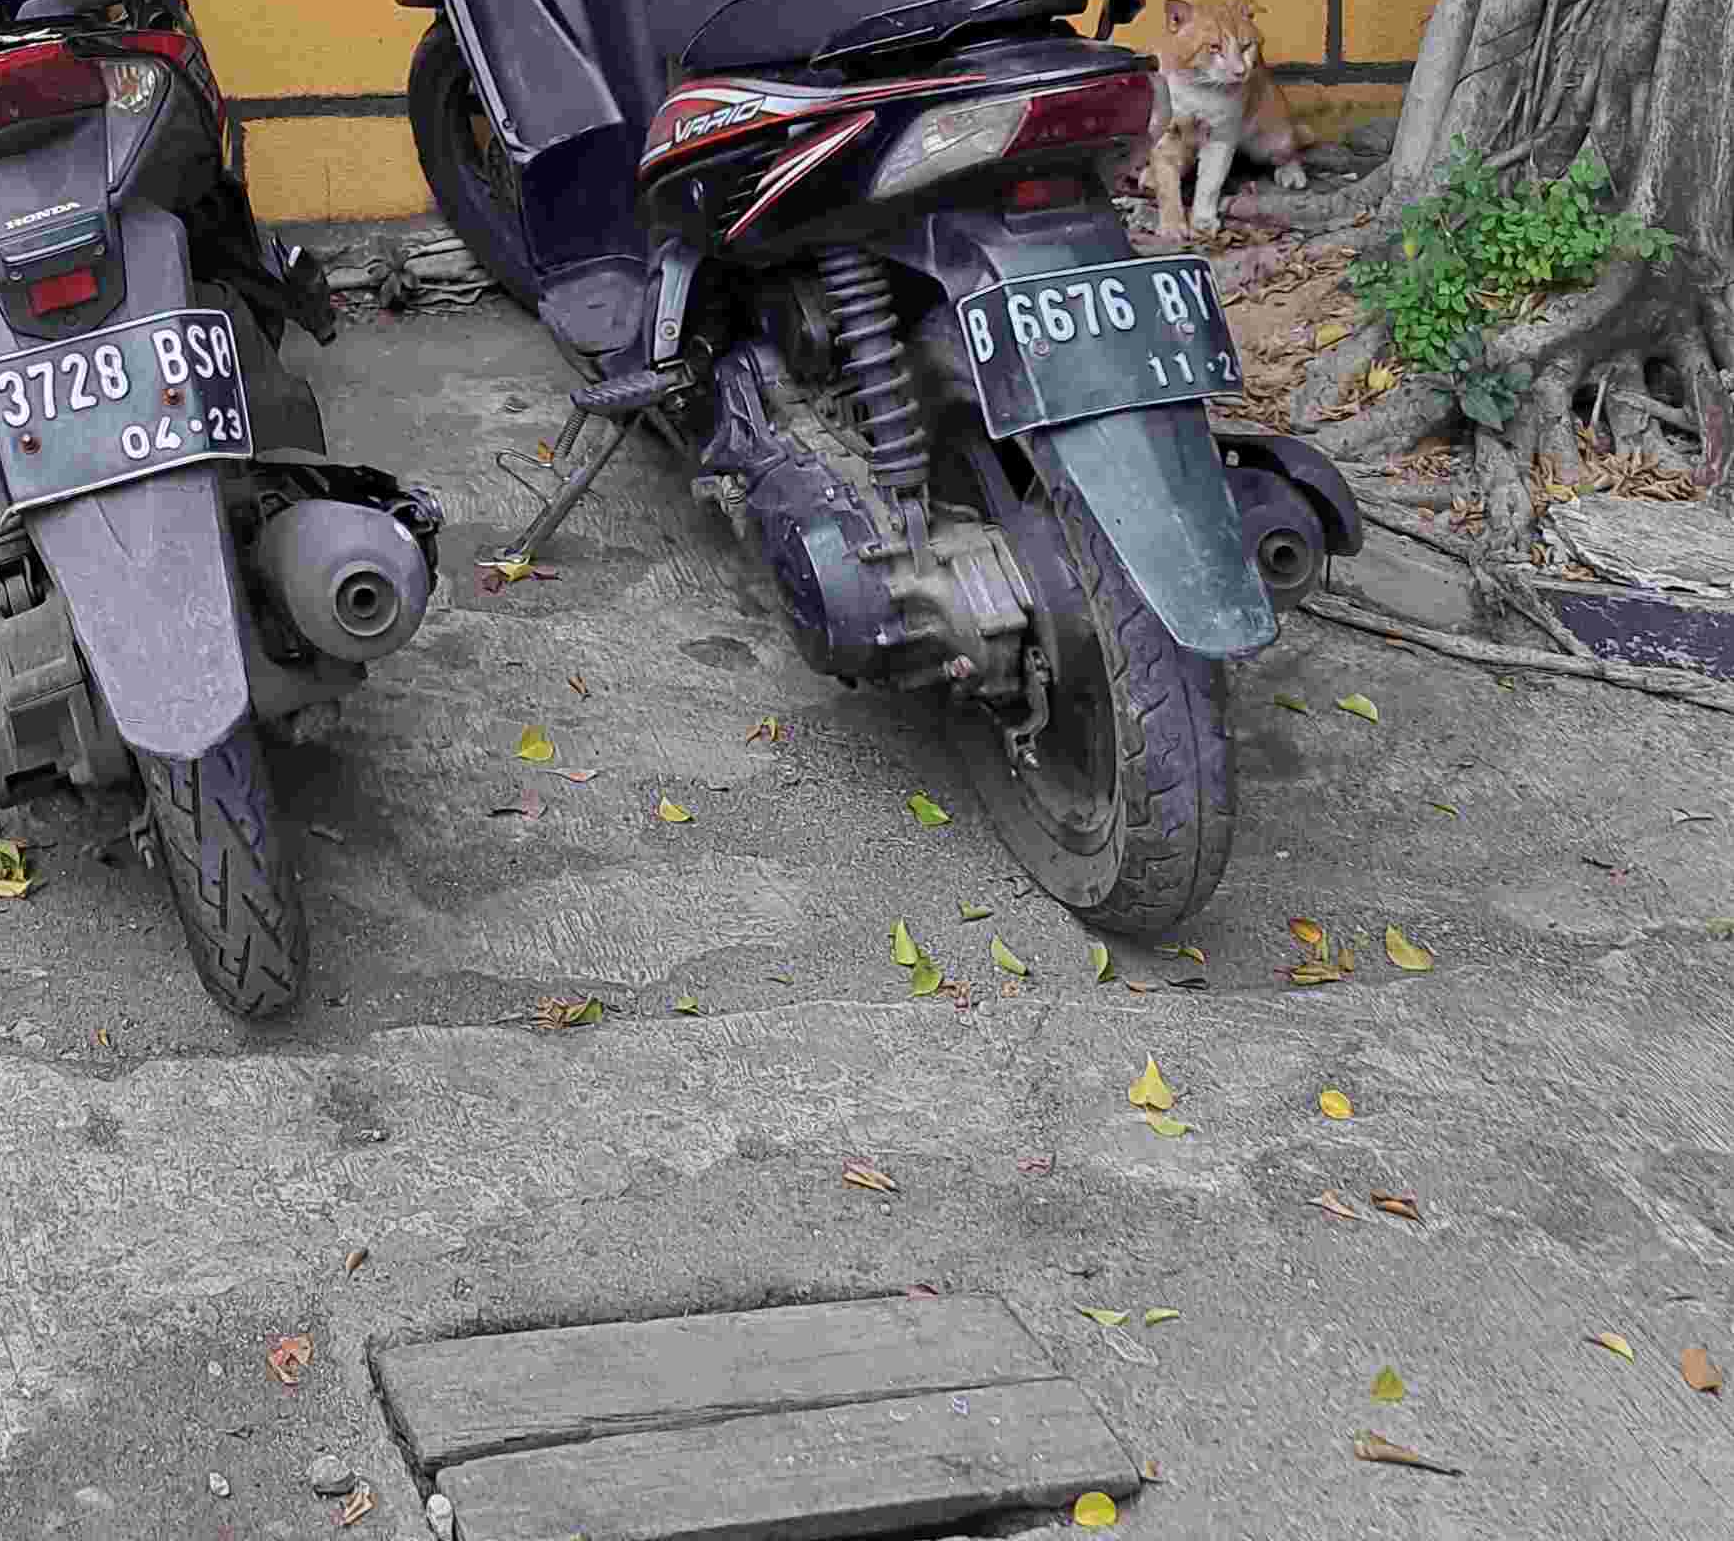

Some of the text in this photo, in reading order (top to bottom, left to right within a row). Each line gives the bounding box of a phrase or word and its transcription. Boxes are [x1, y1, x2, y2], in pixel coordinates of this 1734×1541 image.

[674, 99, 765, 143] VARIO
[6, 201, 81, 230] HONDA
[967, 308, 995, 363] B
[1007, 277, 1136, 346] 6676
